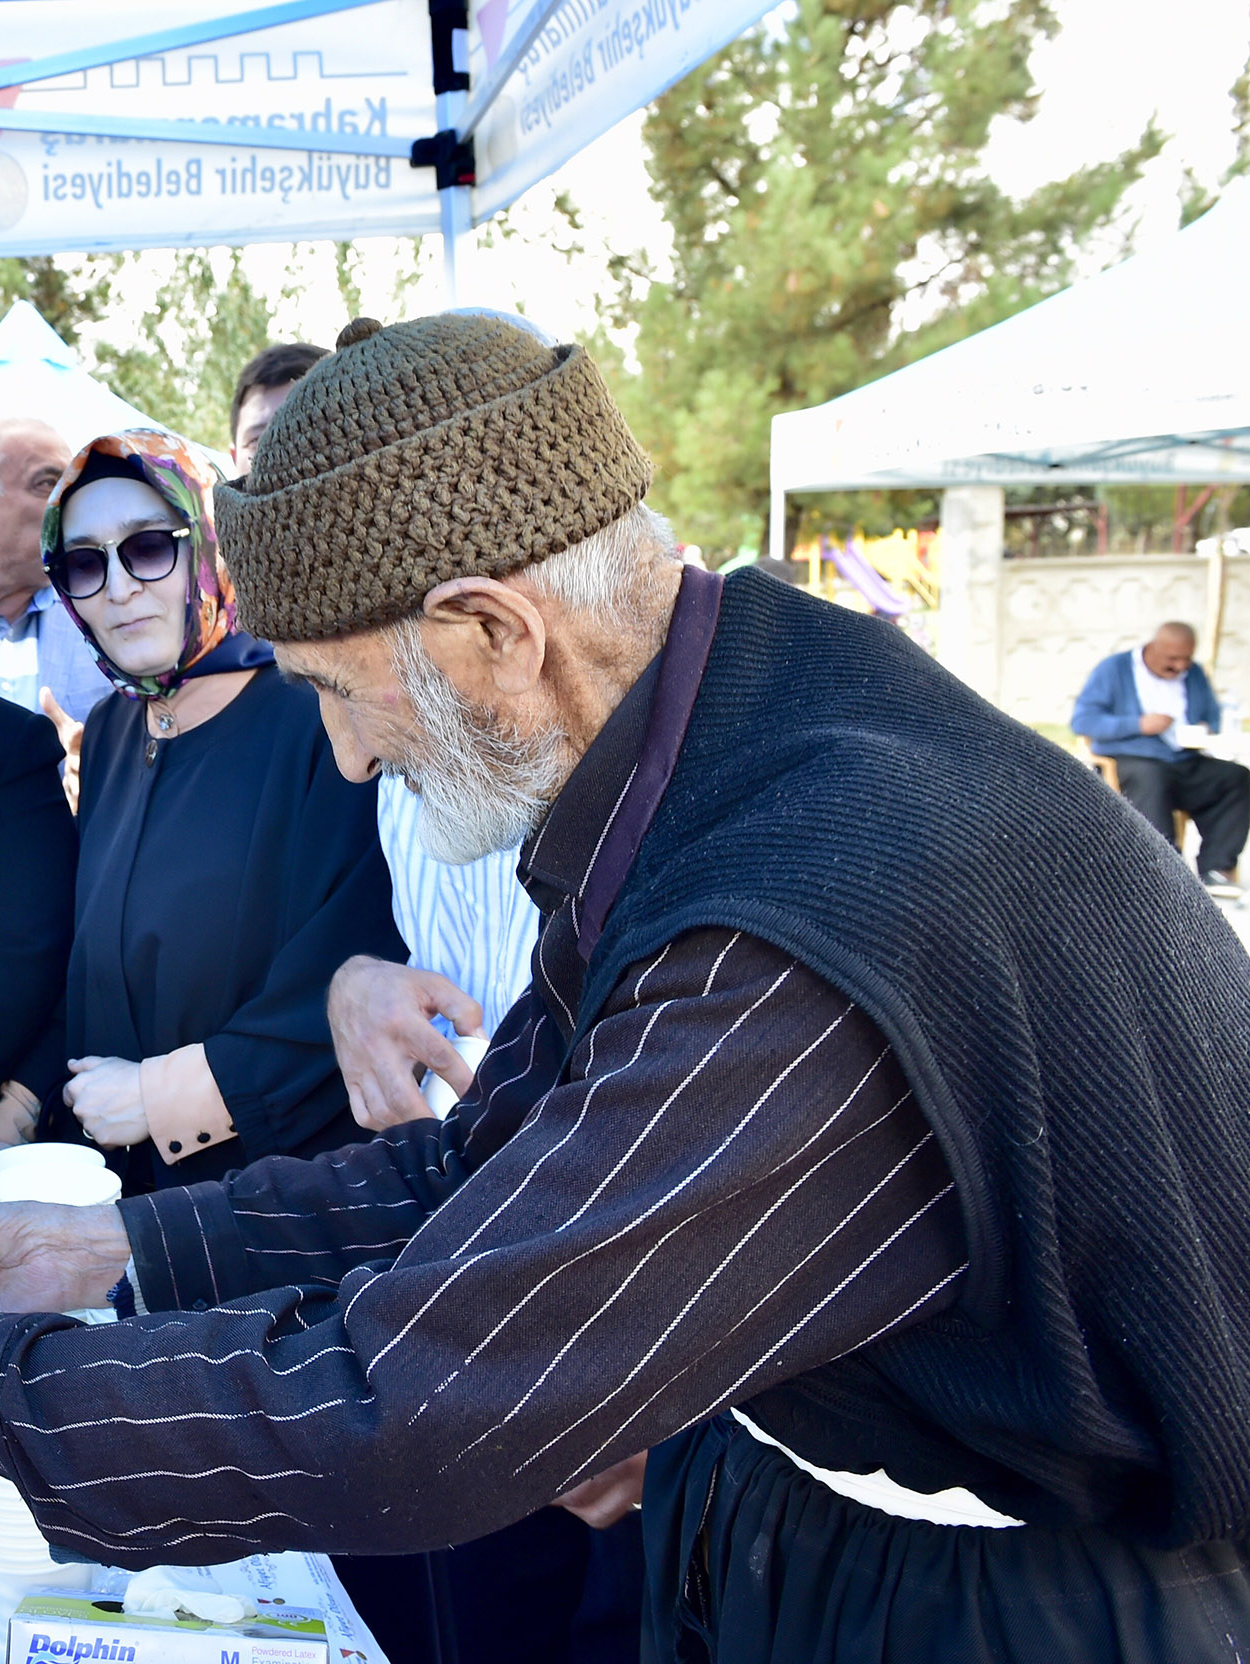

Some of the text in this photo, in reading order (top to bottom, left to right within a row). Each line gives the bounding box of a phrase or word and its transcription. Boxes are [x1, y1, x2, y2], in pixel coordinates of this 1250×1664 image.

[29, 1633, 137, 1662] Dolphin
[251, 1646, 317, 1660] Powdered Latex
[221, 1650, 240, 1664] M
